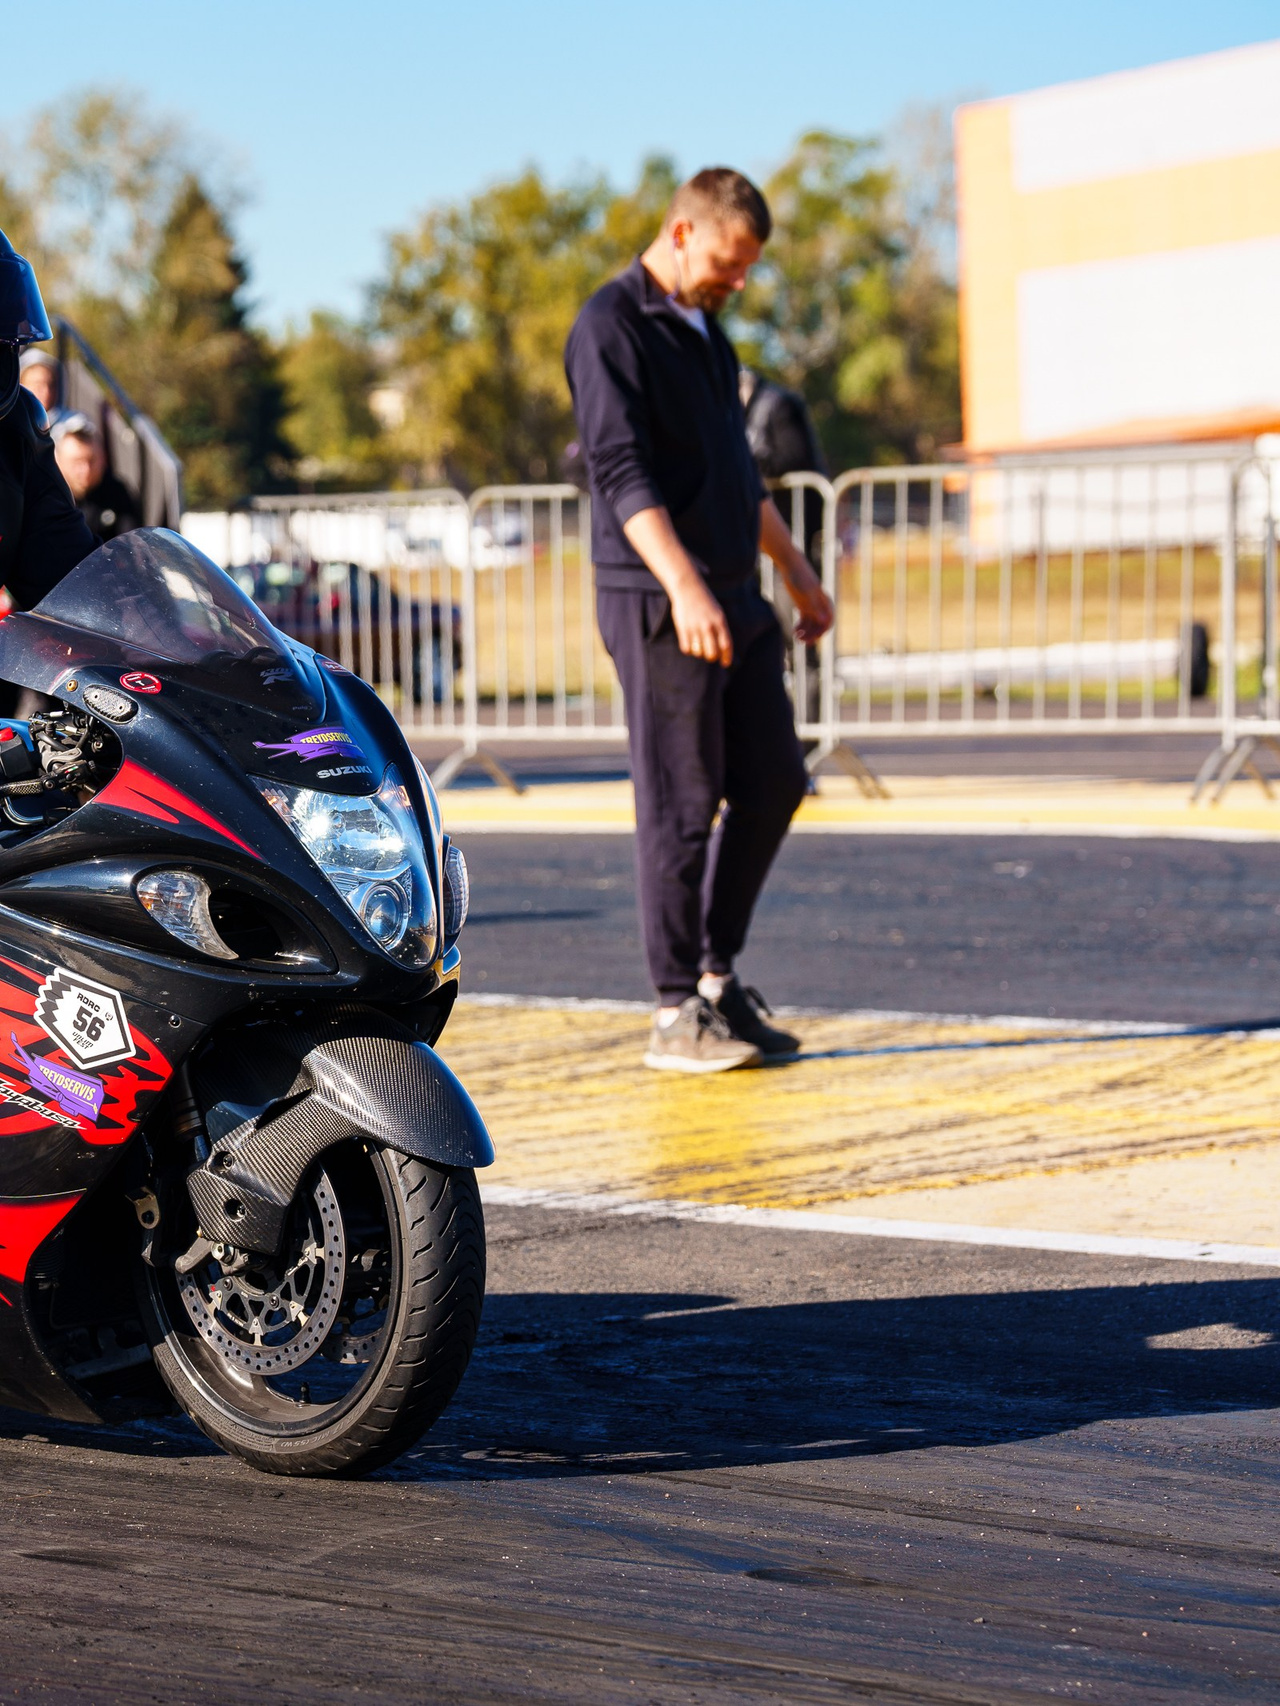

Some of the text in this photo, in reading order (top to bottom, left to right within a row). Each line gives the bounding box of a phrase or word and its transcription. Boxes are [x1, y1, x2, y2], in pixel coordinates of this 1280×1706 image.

[317, 765, 372, 779] SUZUKI
[77, 992, 100, 1012] RDRC
[72, 1005, 105, 1042] 56
[39, 1065, 97, 1102] TREYDSERVIS
